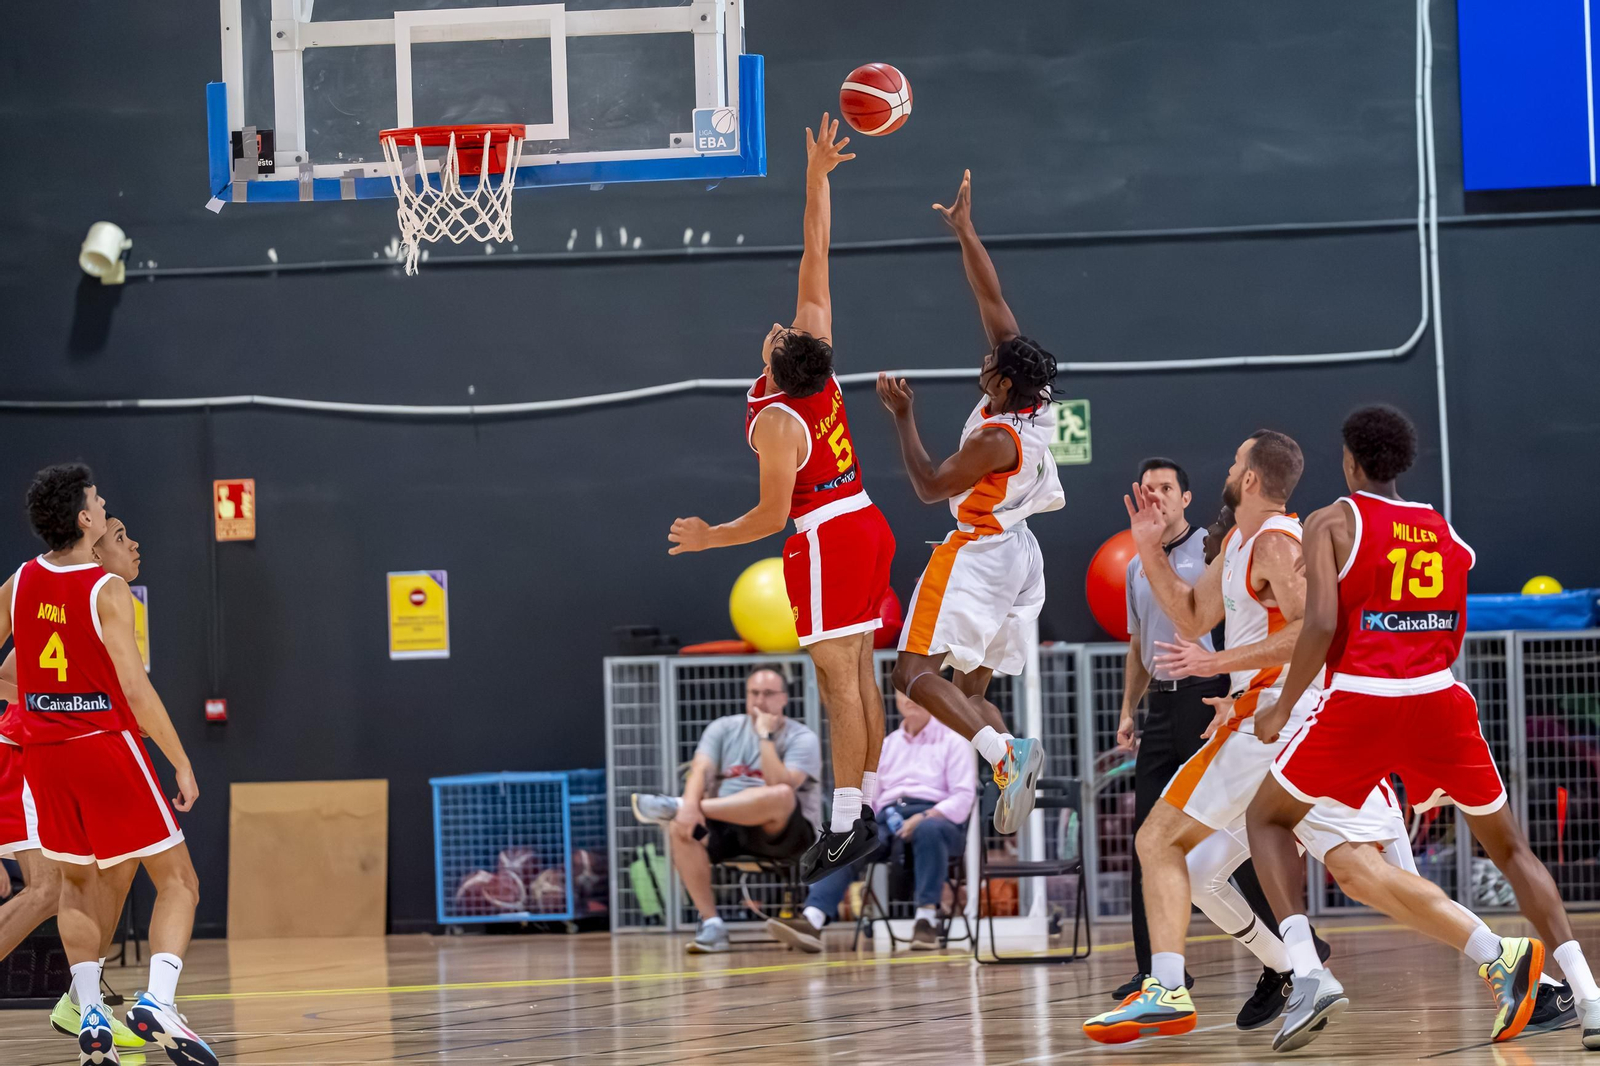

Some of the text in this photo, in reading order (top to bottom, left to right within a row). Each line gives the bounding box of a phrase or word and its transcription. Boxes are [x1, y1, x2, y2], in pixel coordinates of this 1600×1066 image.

[699, 136, 727, 149] EBA
[257, 159, 273, 167] esto
[827, 421, 853, 473] 5
[833, 467, 856, 488] Caixa
[1392, 521, 1438, 543] MILLER
[1386, 548, 1444, 601] 13
[37, 602, 67, 625] ADRIÁ
[39, 631, 68, 682] 4
[36, 694, 108, 712] CaixaBank
